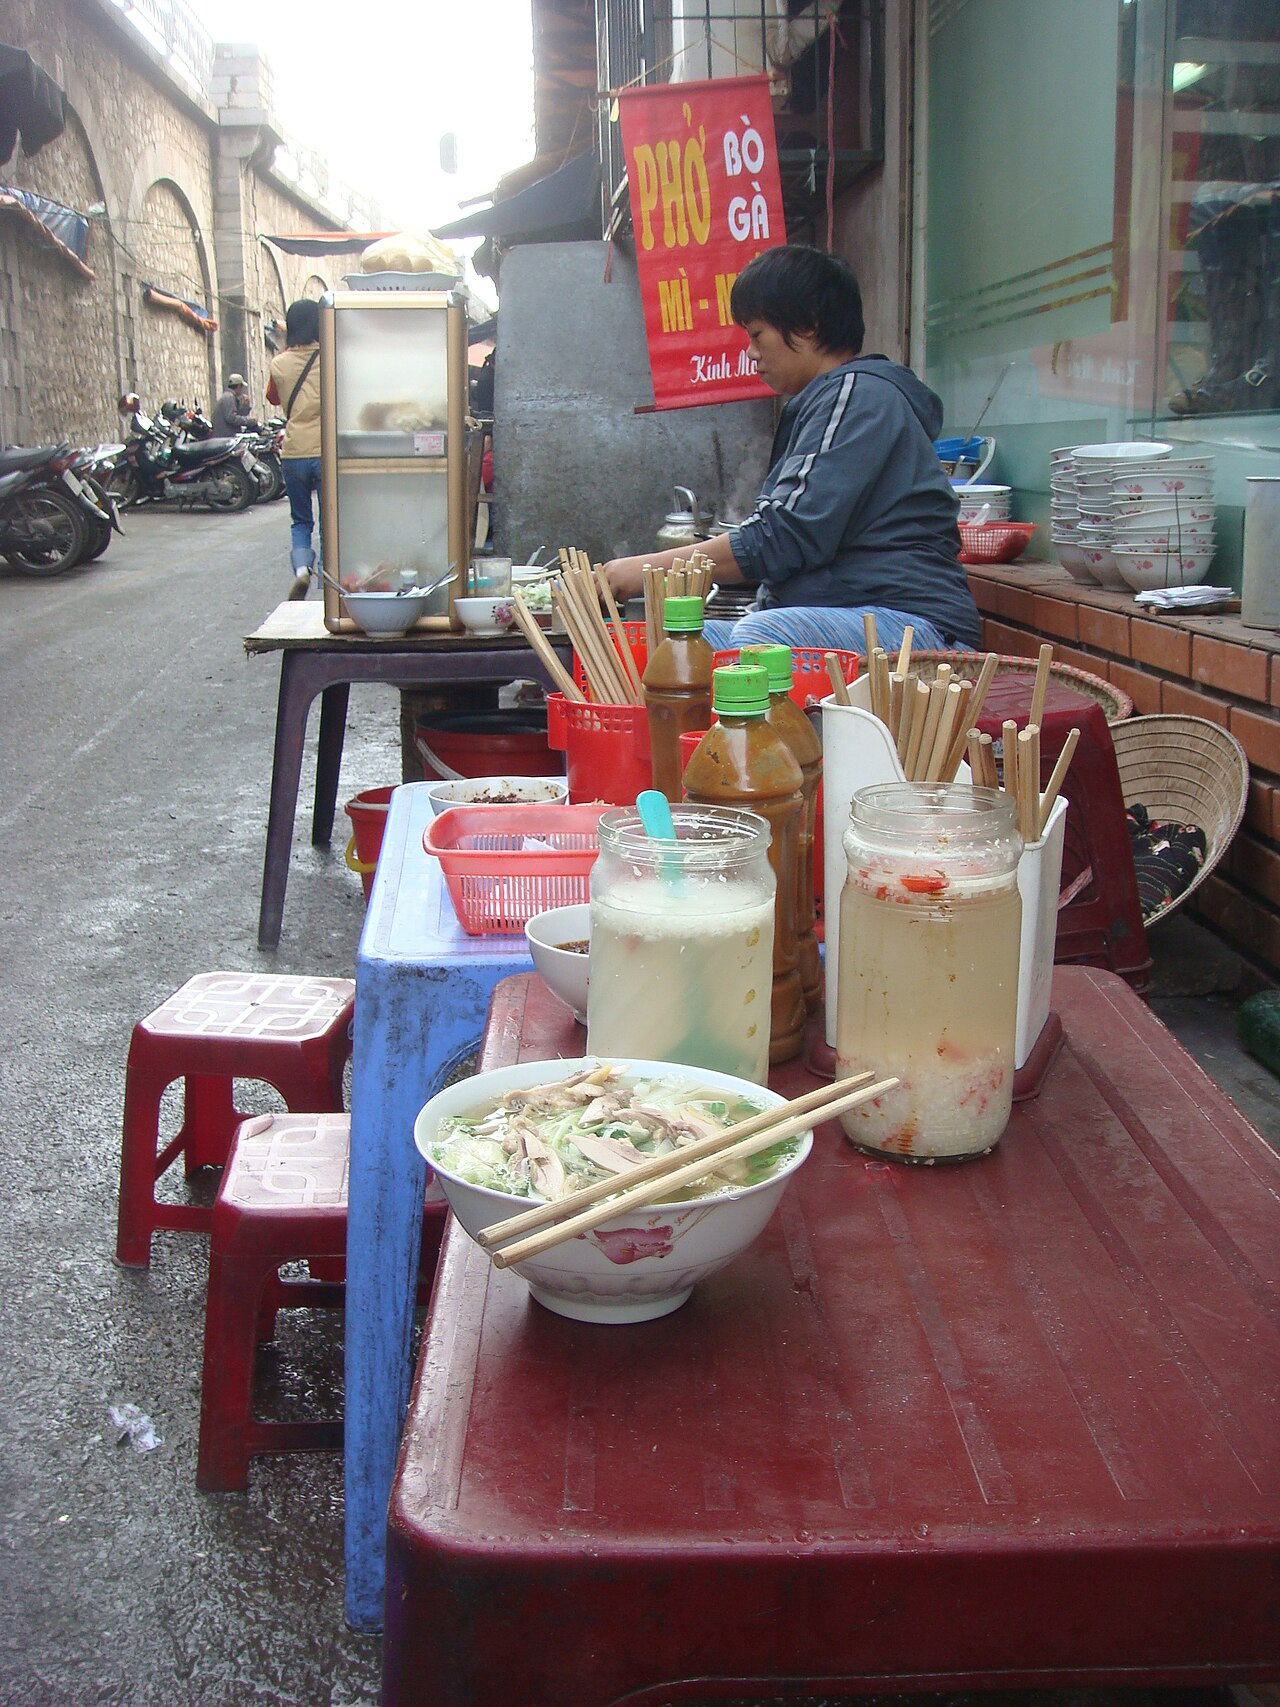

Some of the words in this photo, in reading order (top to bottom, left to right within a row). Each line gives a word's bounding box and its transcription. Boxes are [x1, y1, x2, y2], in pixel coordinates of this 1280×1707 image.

[633, 102, 712, 250] PHỞ
[723, 114, 765, 176] BÒ
[728, 181, 770, 241] GÀ
[658, 267, 693, 333] MÌ
[690, 352, 732, 383] Kính
